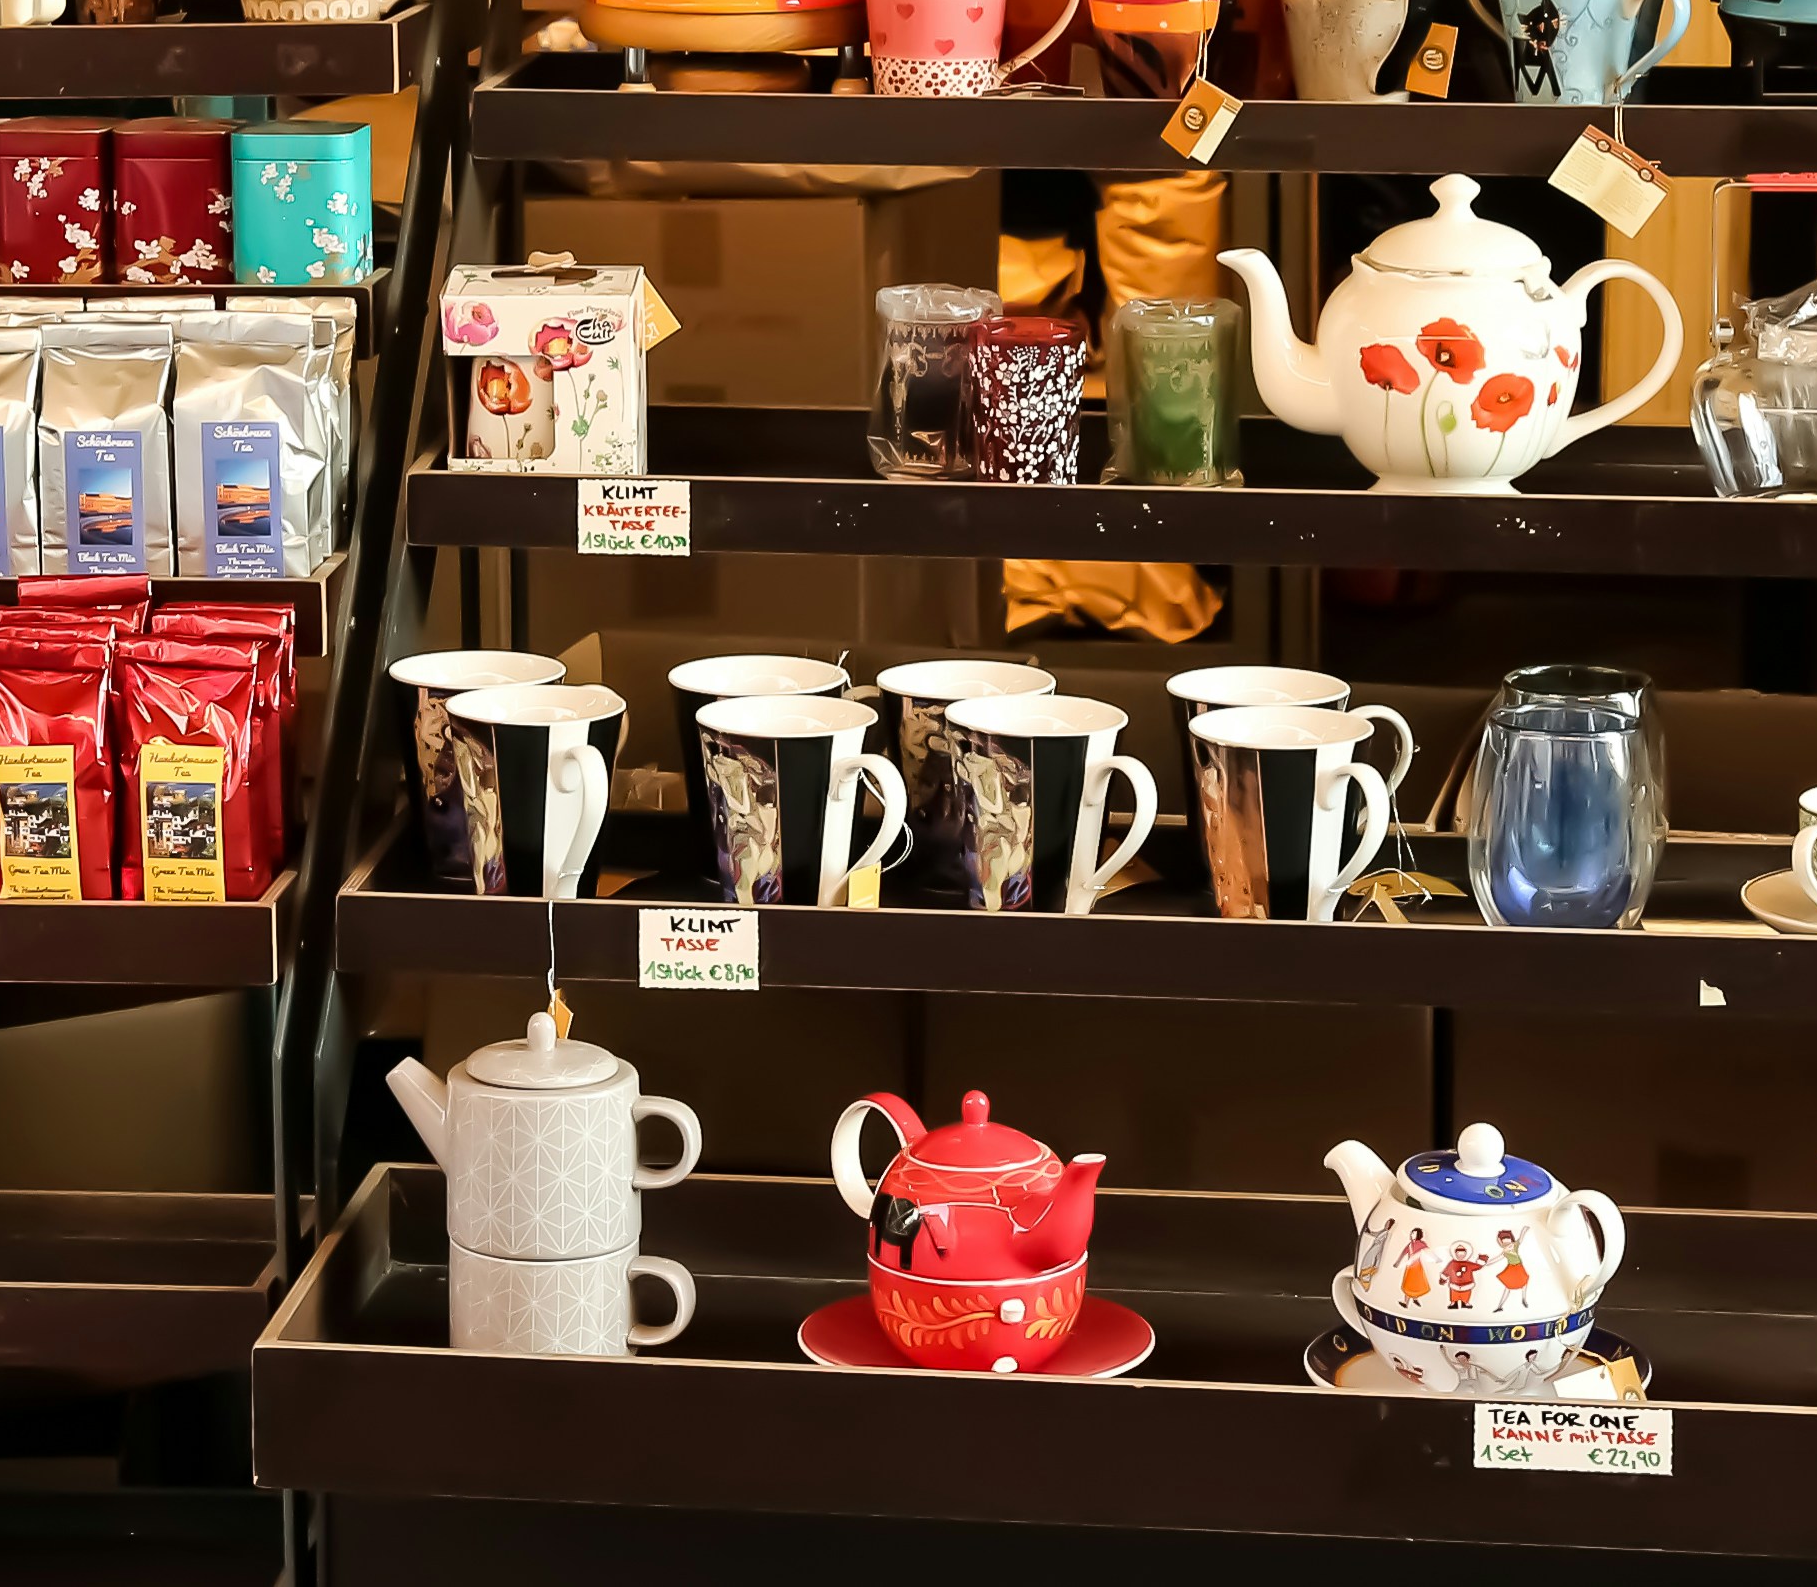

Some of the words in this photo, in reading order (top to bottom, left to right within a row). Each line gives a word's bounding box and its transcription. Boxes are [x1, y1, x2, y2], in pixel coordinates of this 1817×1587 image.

[601, 485, 659, 500] KLIMT
[609, 520, 656, 532] TASSE
[670, 915, 742, 934] KLIMT
[660, 937, 721, 952] TASSE
[1488, 1408, 1531, 1426] TEA
[1541, 1410, 1585, 1427] FOR
[1589, 1413, 1640, 1431] ONE
[1491, 1426, 1565, 1444] KANNE
[1601, 1430, 1659, 1446] TASSE
